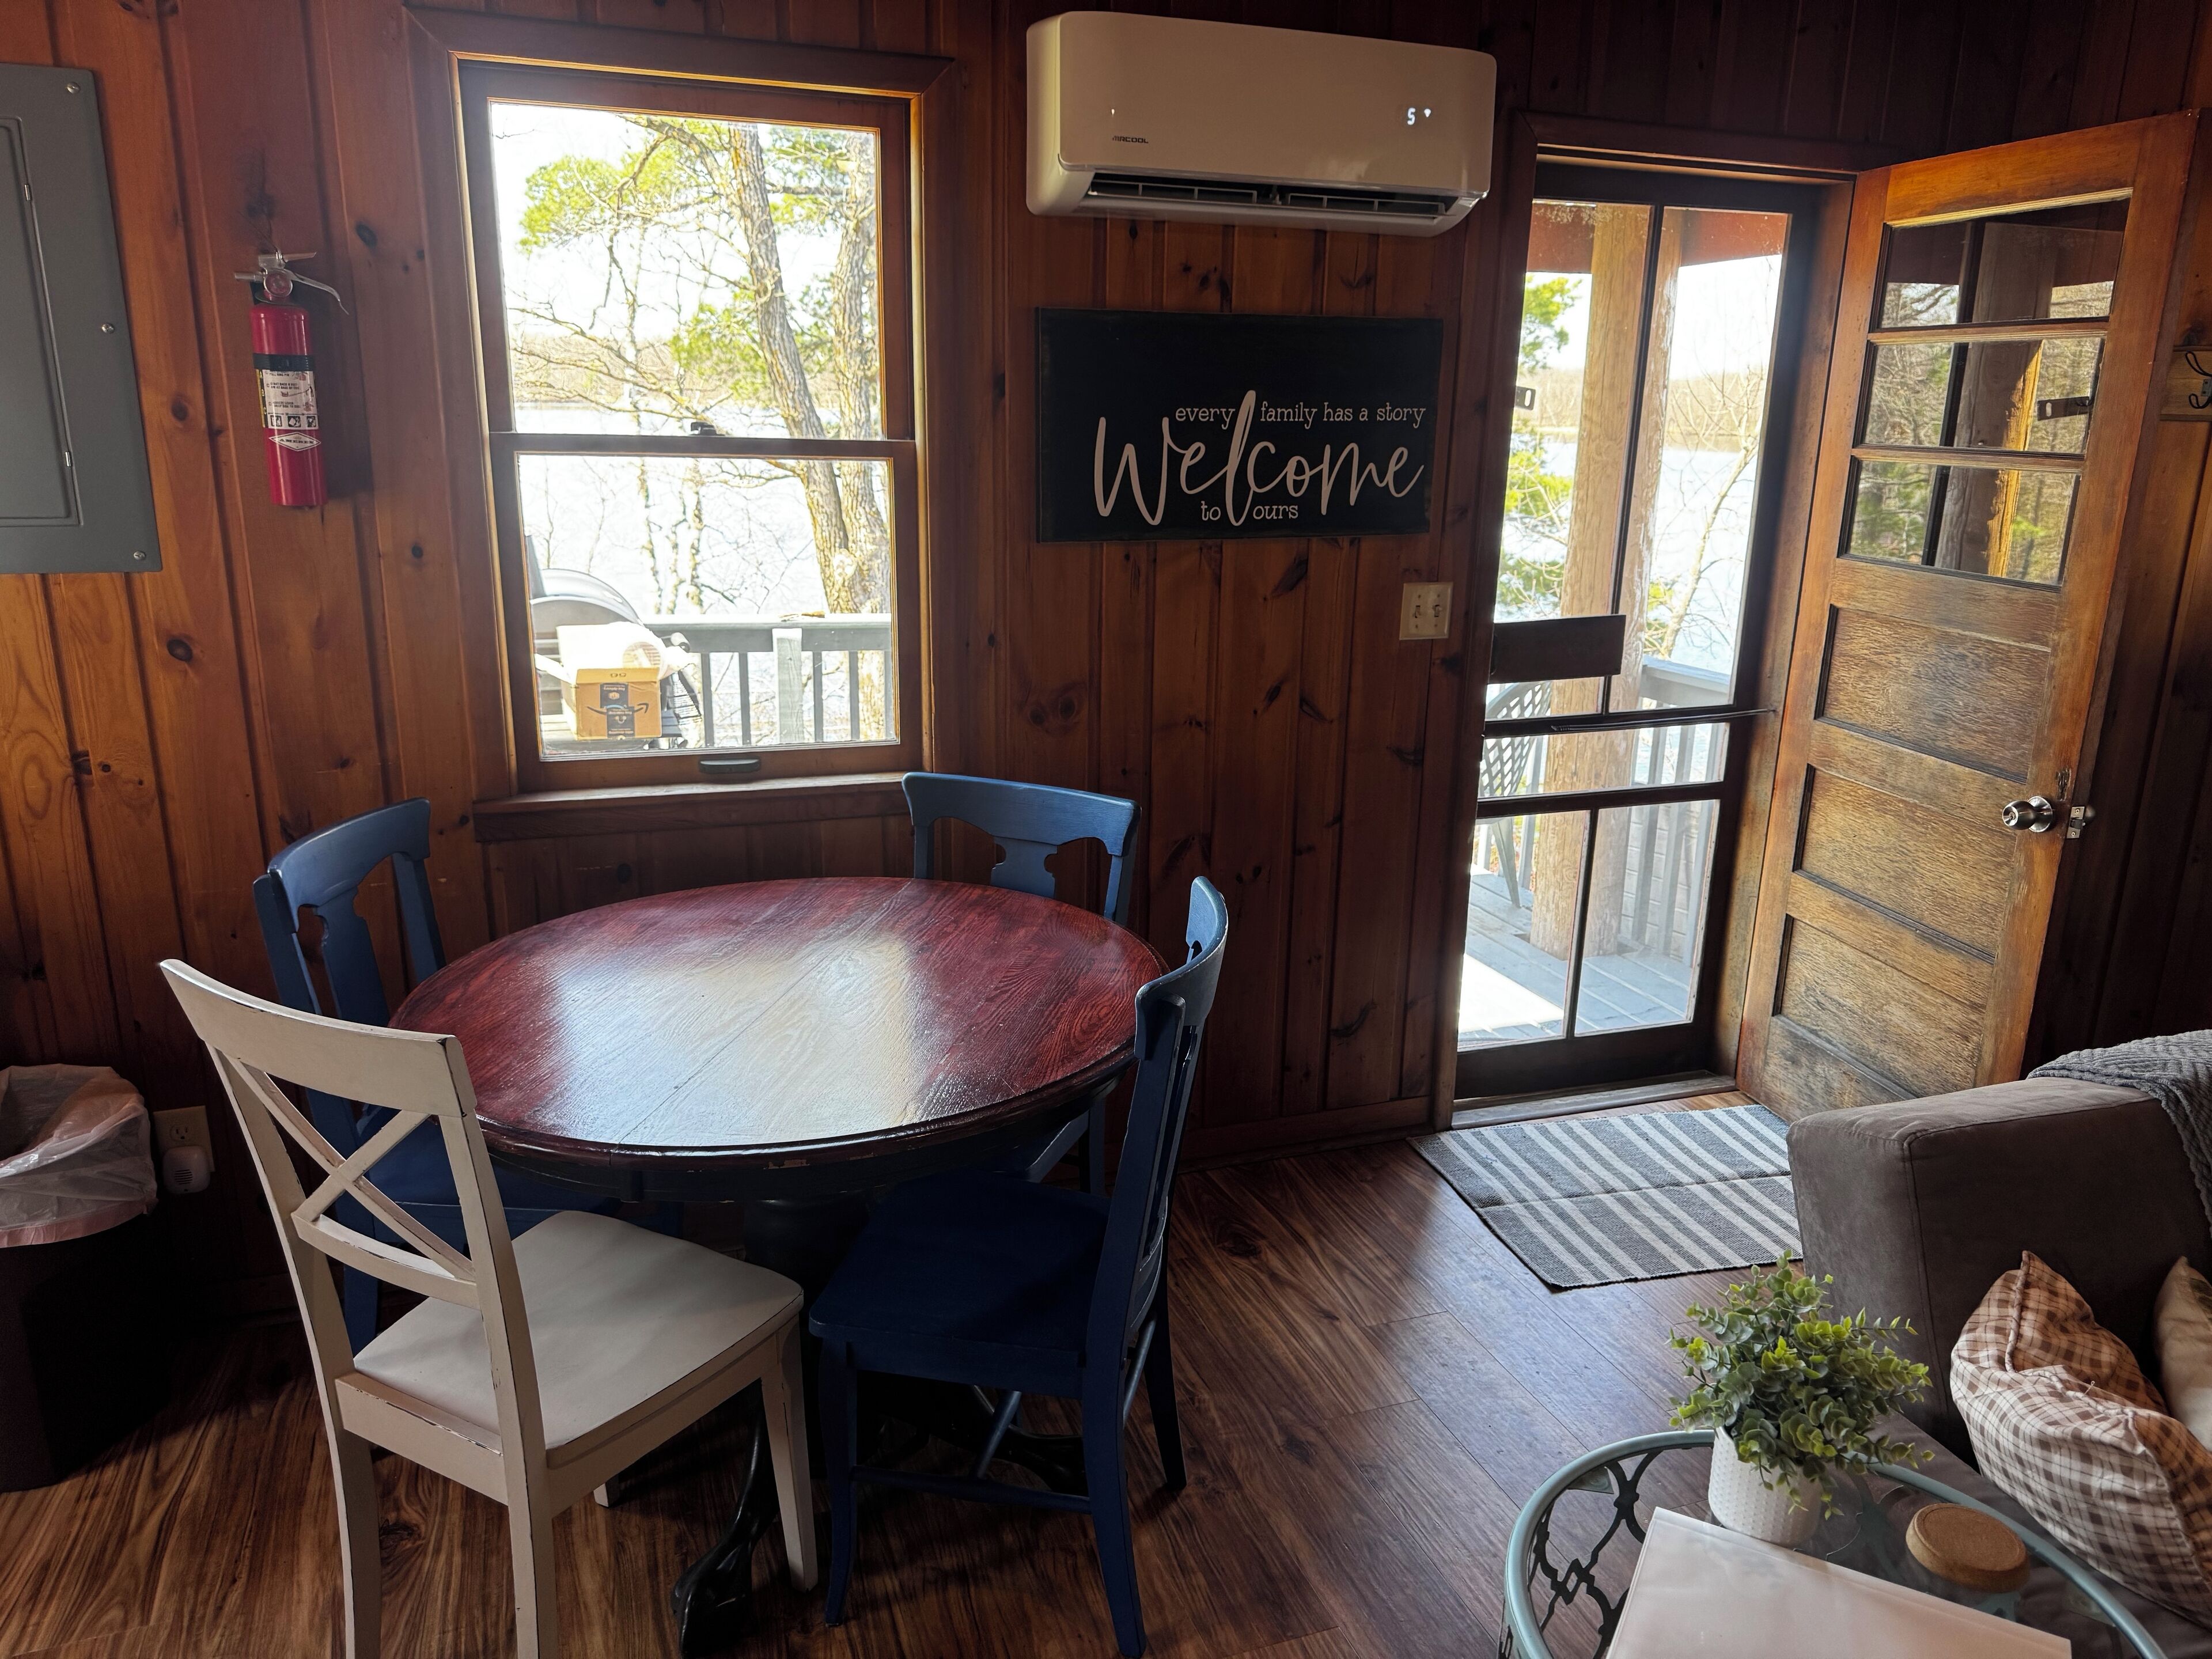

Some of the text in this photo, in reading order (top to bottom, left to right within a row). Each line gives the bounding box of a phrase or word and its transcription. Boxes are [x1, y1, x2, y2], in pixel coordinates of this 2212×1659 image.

[1175, 402, 1426, 430] every family has a story
[1200, 501, 1299, 521] to ours
